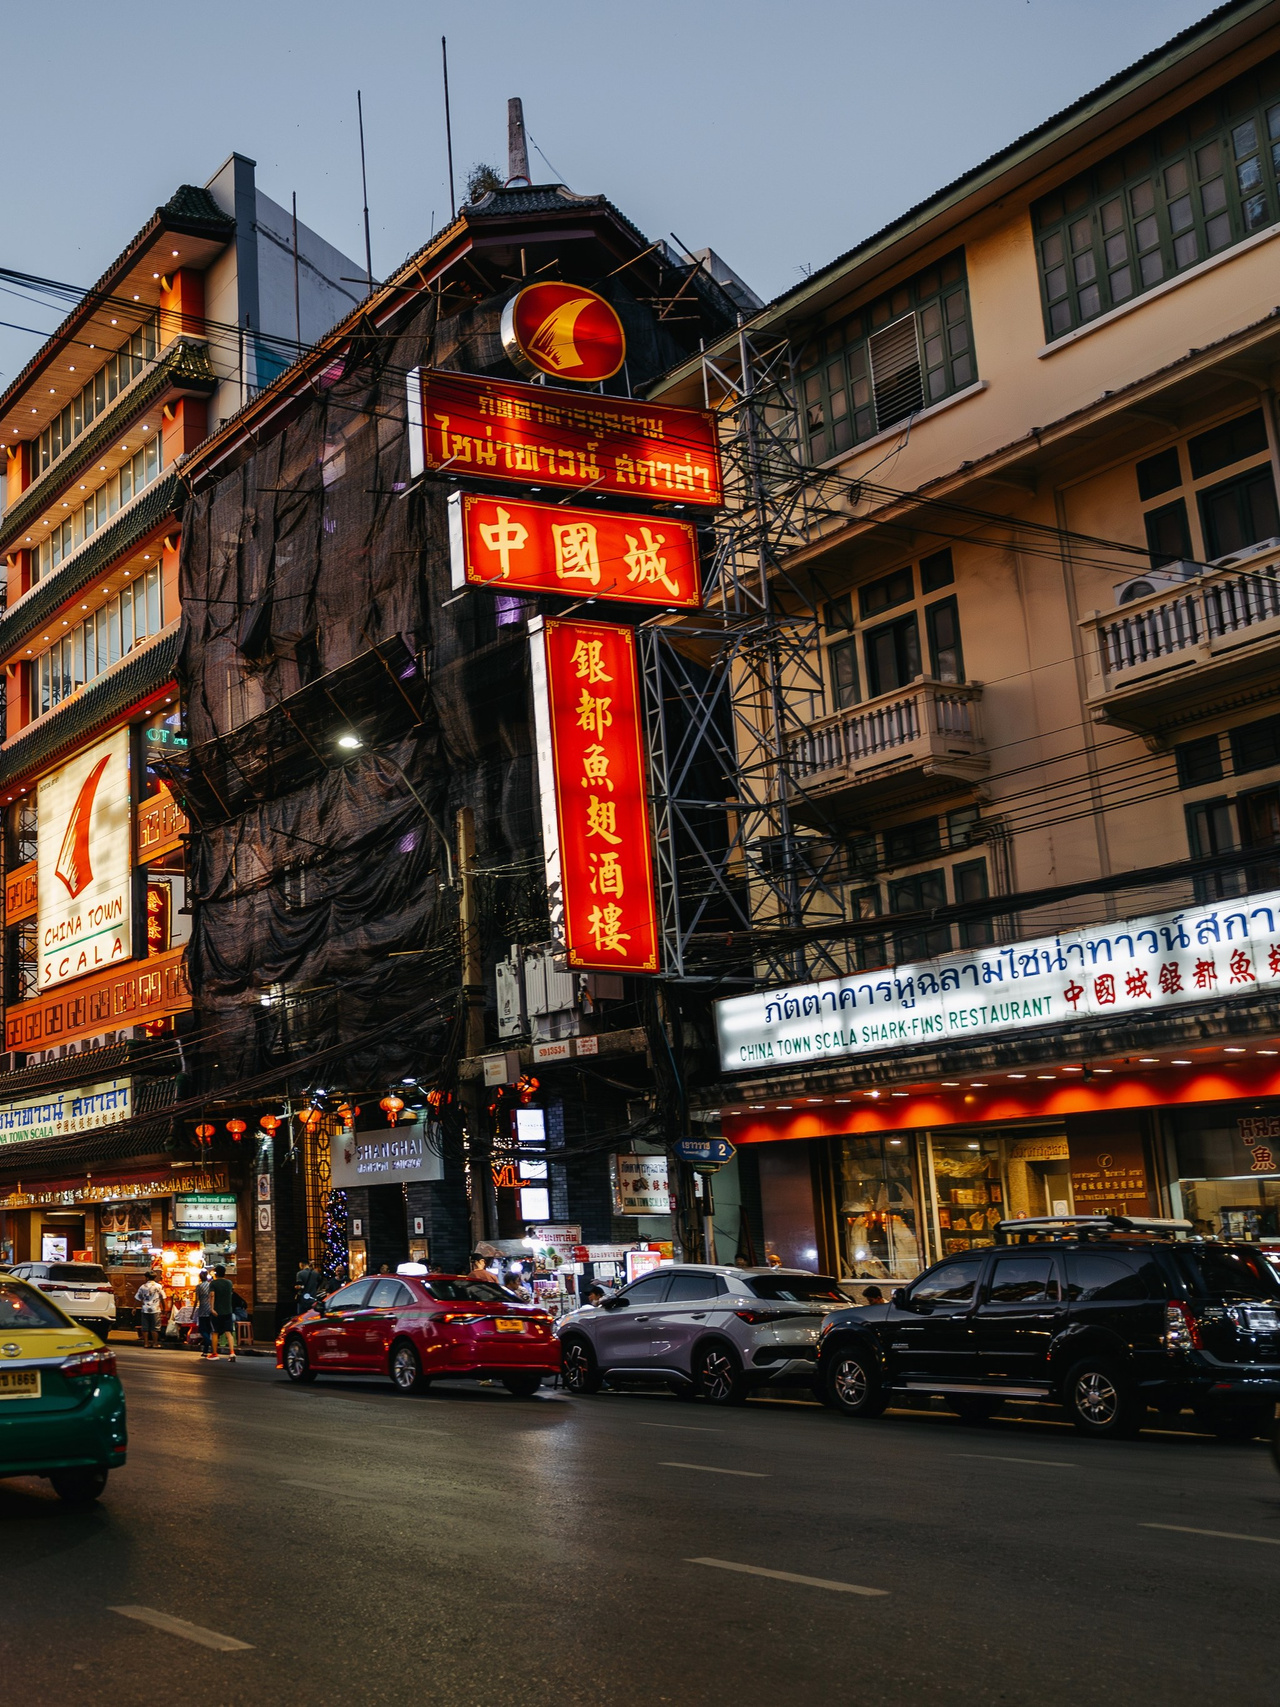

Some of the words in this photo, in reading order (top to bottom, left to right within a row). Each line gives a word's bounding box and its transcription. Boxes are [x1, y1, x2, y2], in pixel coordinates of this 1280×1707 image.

[434, 413, 600, 480] ไชน่าทาวน์
[479, 506, 680, 597] 中國城
[570, 638, 632, 957] 銀都魚翅酒樓
[44, 913, 82, 947] CHINA
[88, 896, 123, 930] TOWN
[44, 937, 123, 984] SCALA
[739, 1041, 774, 1062] CHINA
[777, 1035, 811, 1055] TOWN
[815, 1028, 857, 1050] SCALA
[949, 996, 1052, 1029] RESTAURANT
[9, 1130, 29, 1143] TOWN
[30, 1126, 53, 1140] SCALA
[357, 1139, 423, 1161] SHANGHAI
[718, 1143, 726, 1156] 2
[1251, 1145, 1276, 1171] 魚
